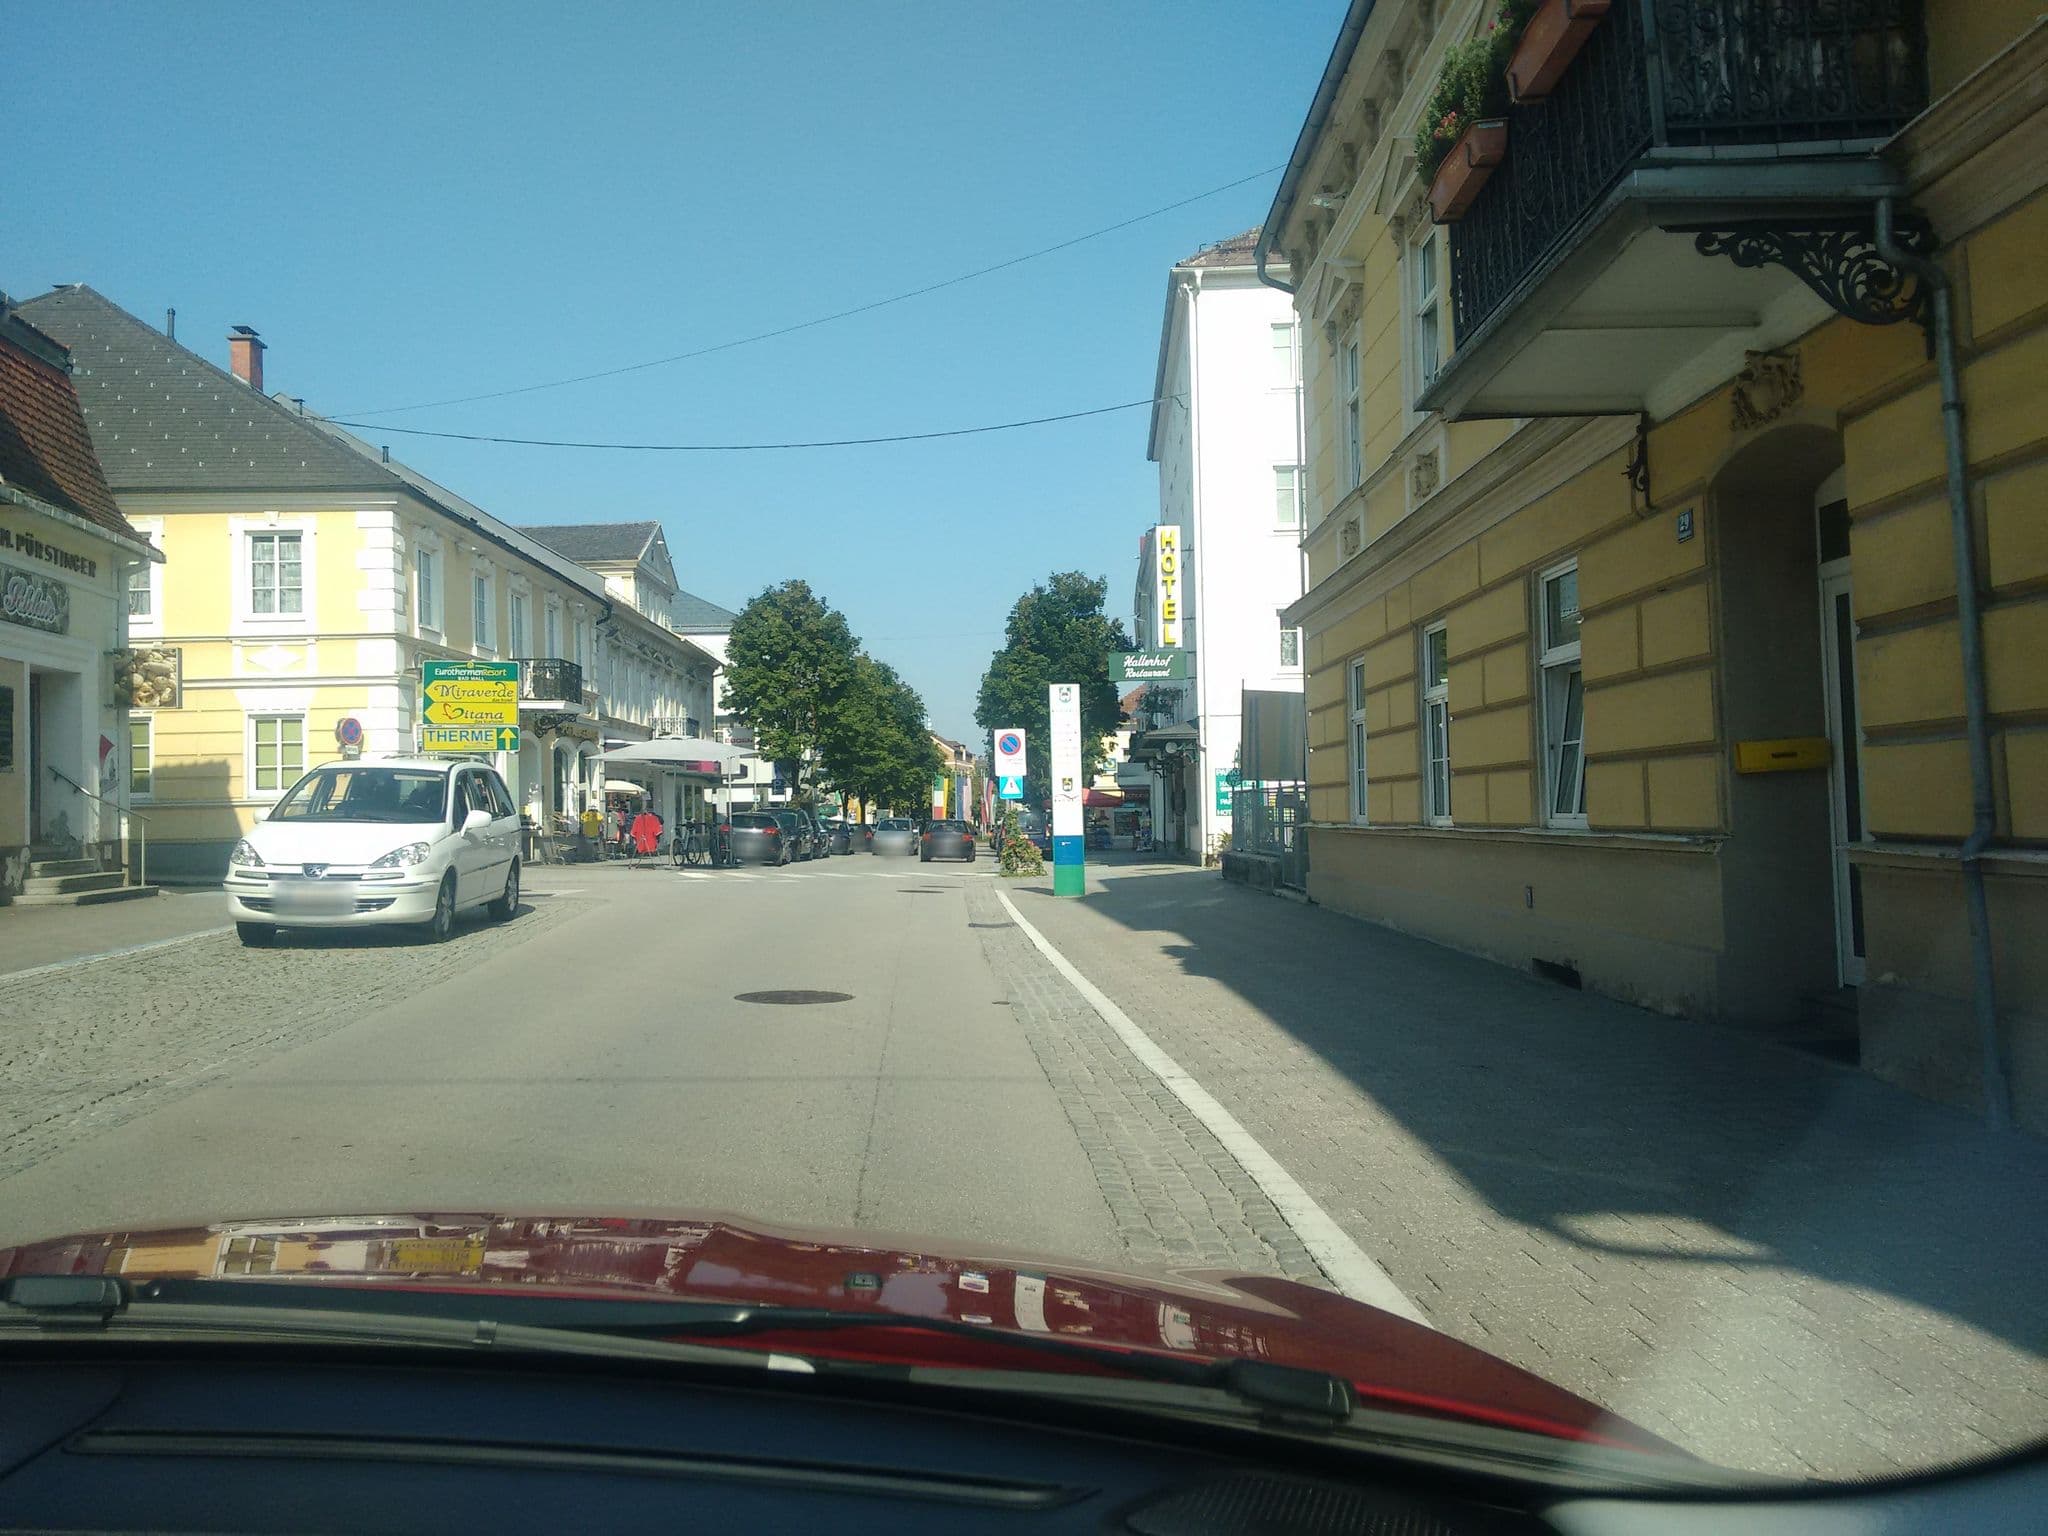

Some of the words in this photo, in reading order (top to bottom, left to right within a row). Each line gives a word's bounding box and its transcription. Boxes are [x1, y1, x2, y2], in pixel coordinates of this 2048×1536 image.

[1160, 530, 1177, 645] HOTEL
[1123, 654, 1174, 668] Hallerhof
[1125, 667, 1171, 678] Restaurant
[434, 682, 514, 699] Miraverde
[427, 730, 494, 742] THERME
